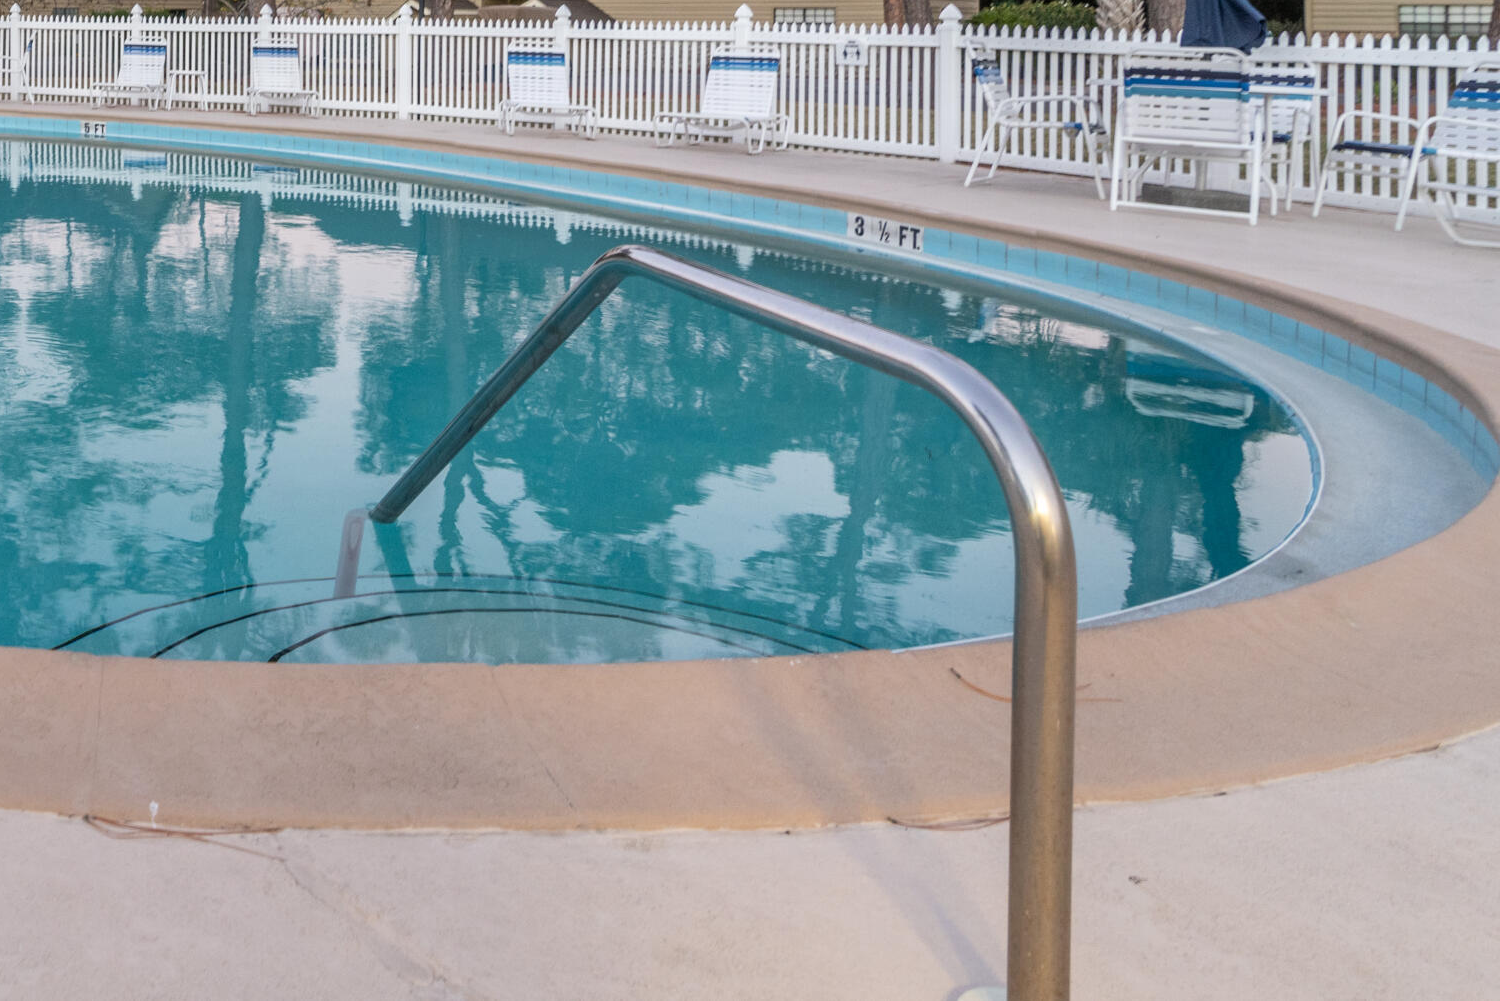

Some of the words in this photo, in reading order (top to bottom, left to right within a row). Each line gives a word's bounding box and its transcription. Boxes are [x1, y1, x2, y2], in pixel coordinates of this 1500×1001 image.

[84, 122, 90, 133] 5
[855, 216, 864, 236] 3
[899, 225, 920, 250] FT.
